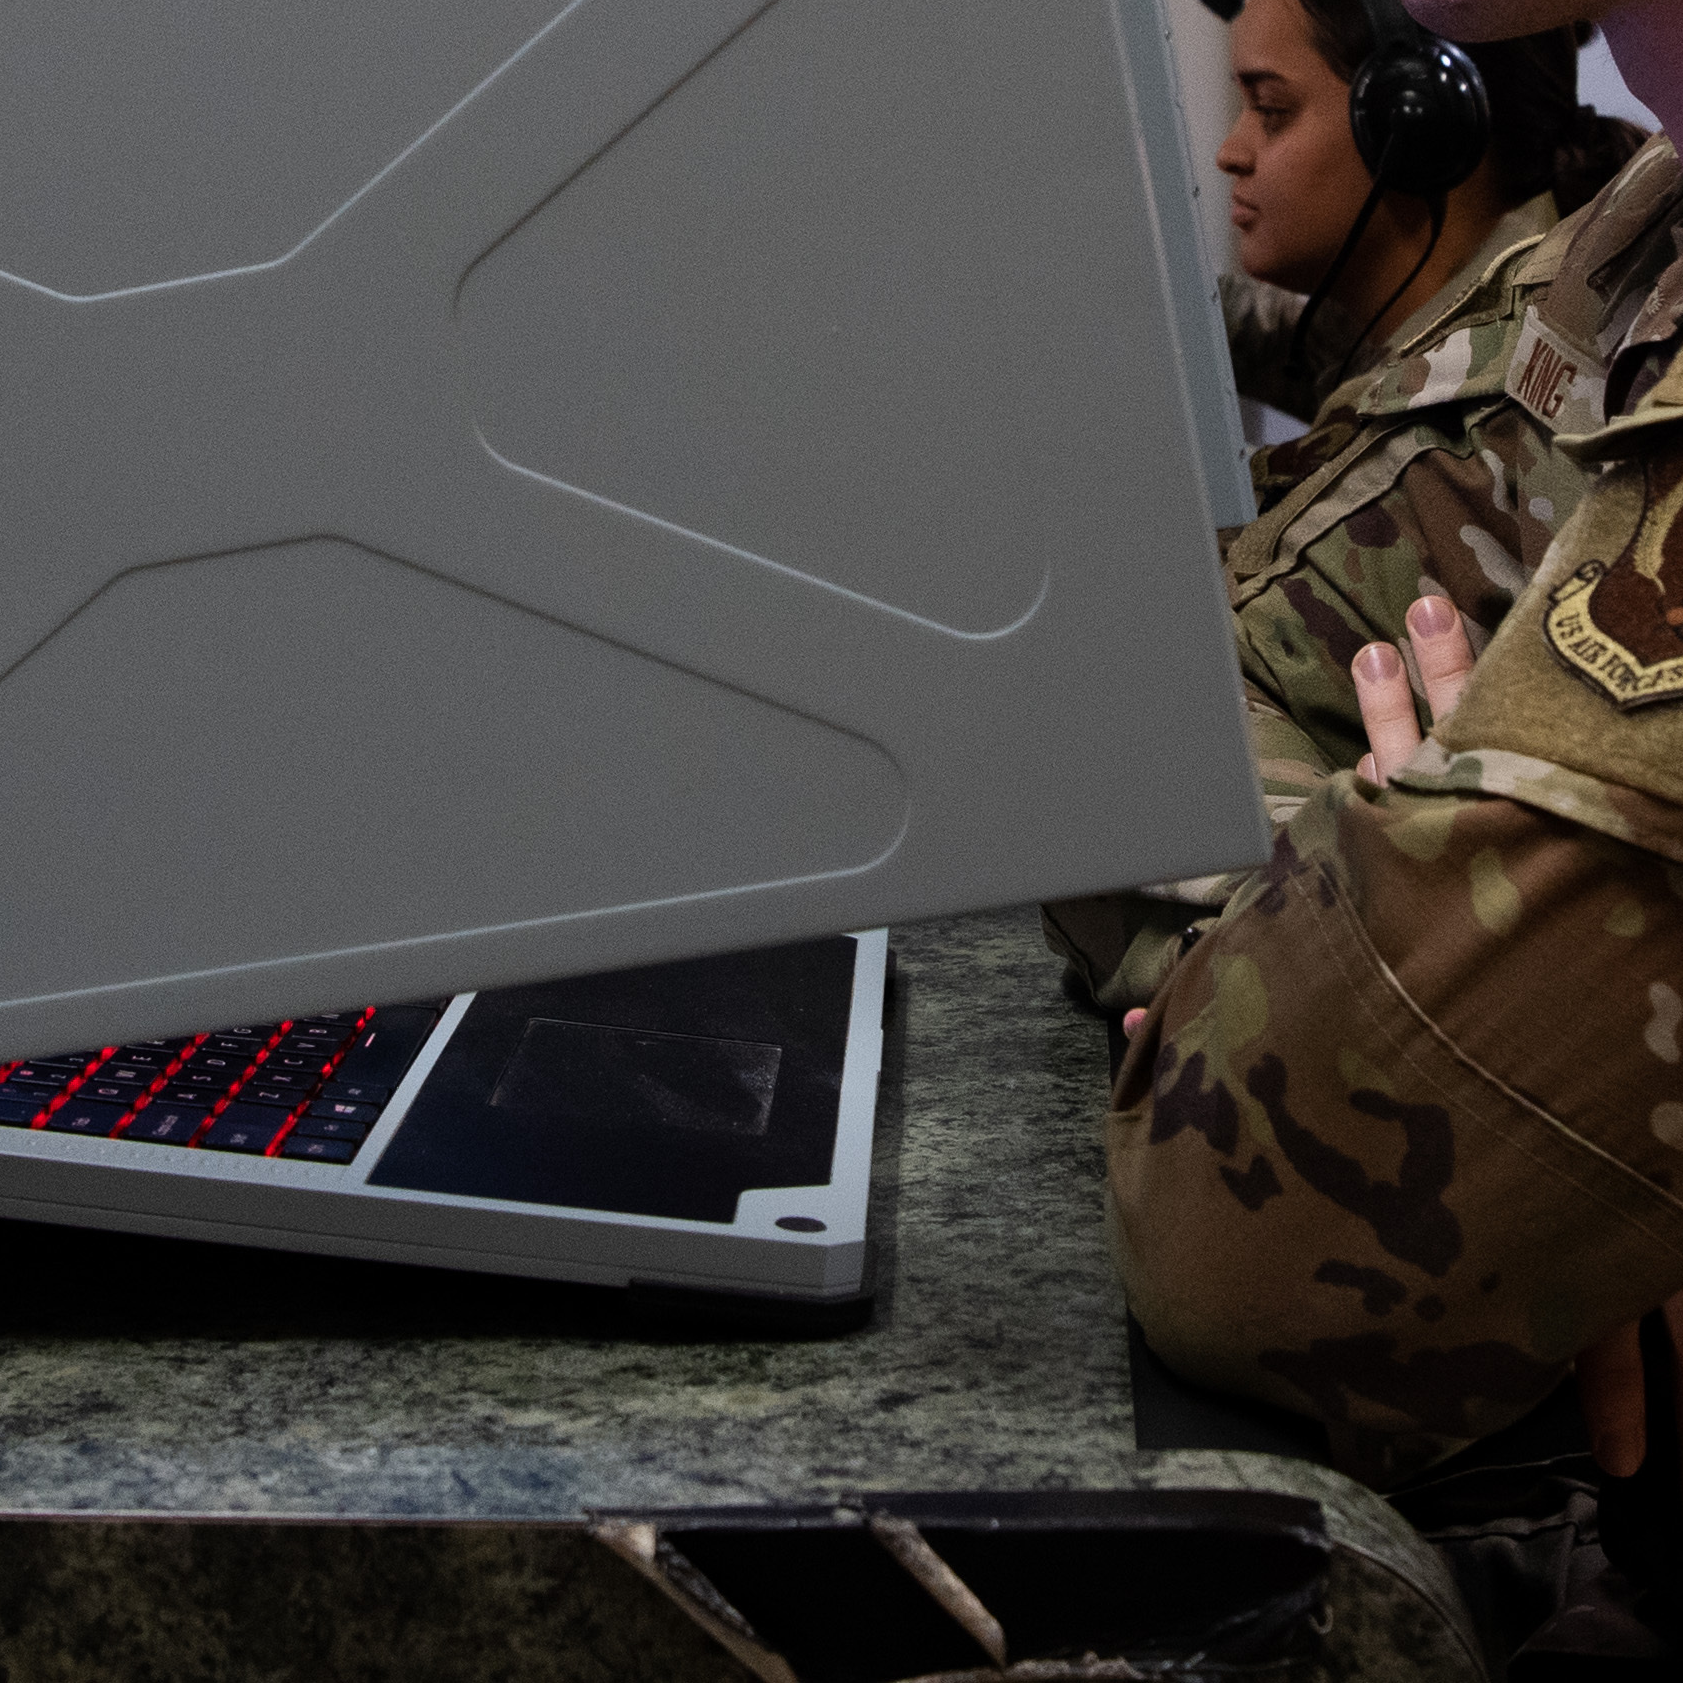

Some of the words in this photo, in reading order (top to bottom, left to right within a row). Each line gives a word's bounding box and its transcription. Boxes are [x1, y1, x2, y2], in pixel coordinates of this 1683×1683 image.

[1516, 337, 1578, 419] KING
[1555, 612, 1583, 641] US
[1567, 635, 1609, 665] AIR
